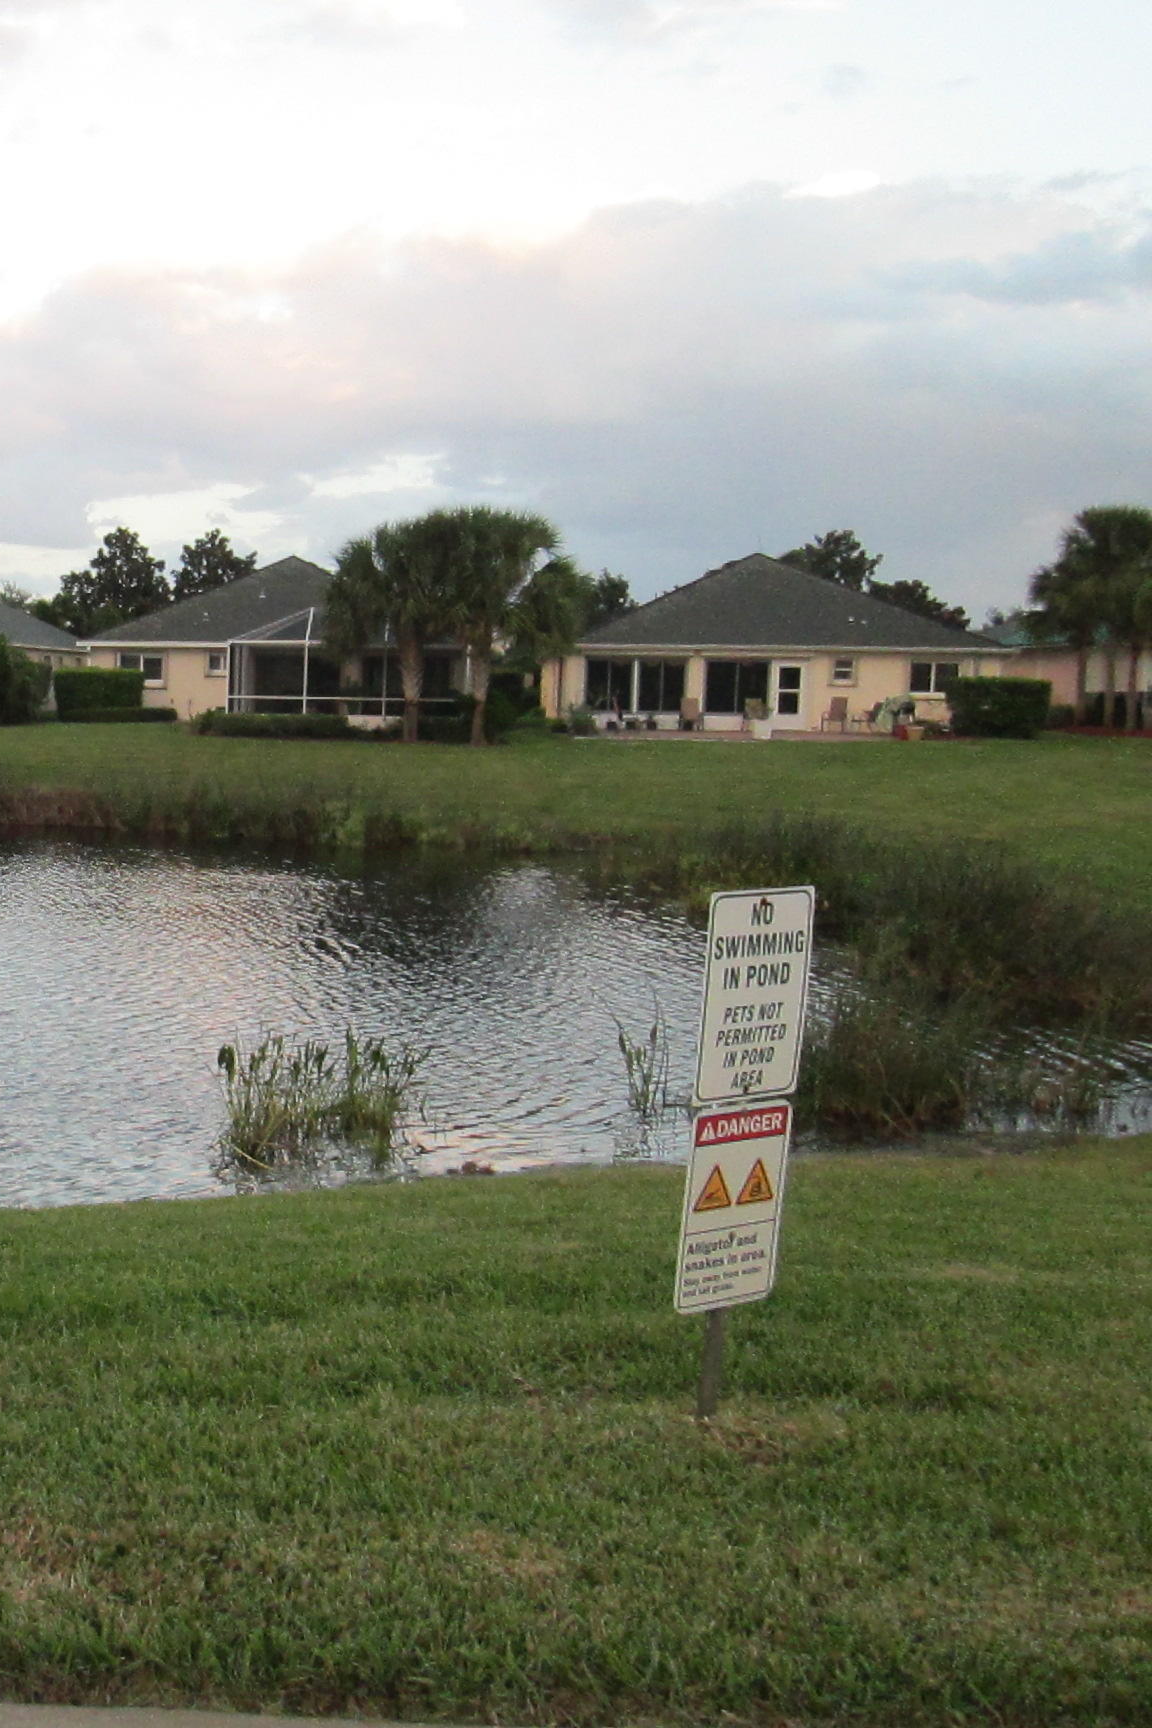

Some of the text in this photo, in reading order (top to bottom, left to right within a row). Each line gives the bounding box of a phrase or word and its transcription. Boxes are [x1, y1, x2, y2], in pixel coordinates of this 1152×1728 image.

[751, 902, 774, 926] NO
[714, 930, 805, 960] SWIMMING
[723, 962, 791, 990] IN POND
[723, 1002, 784, 1025] PETS NOT
[715, 1024, 787, 1047] PERMITTED
[722, 1046, 775, 1068] IN POND
[730, 1070, 763, 1089] AREA
[715, 1112, 784, 1138] DANGER
[736, 1232, 757, 1246] and
[684, 1257, 724, 1272] snakes
[727, 1252, 738, 1263] in
